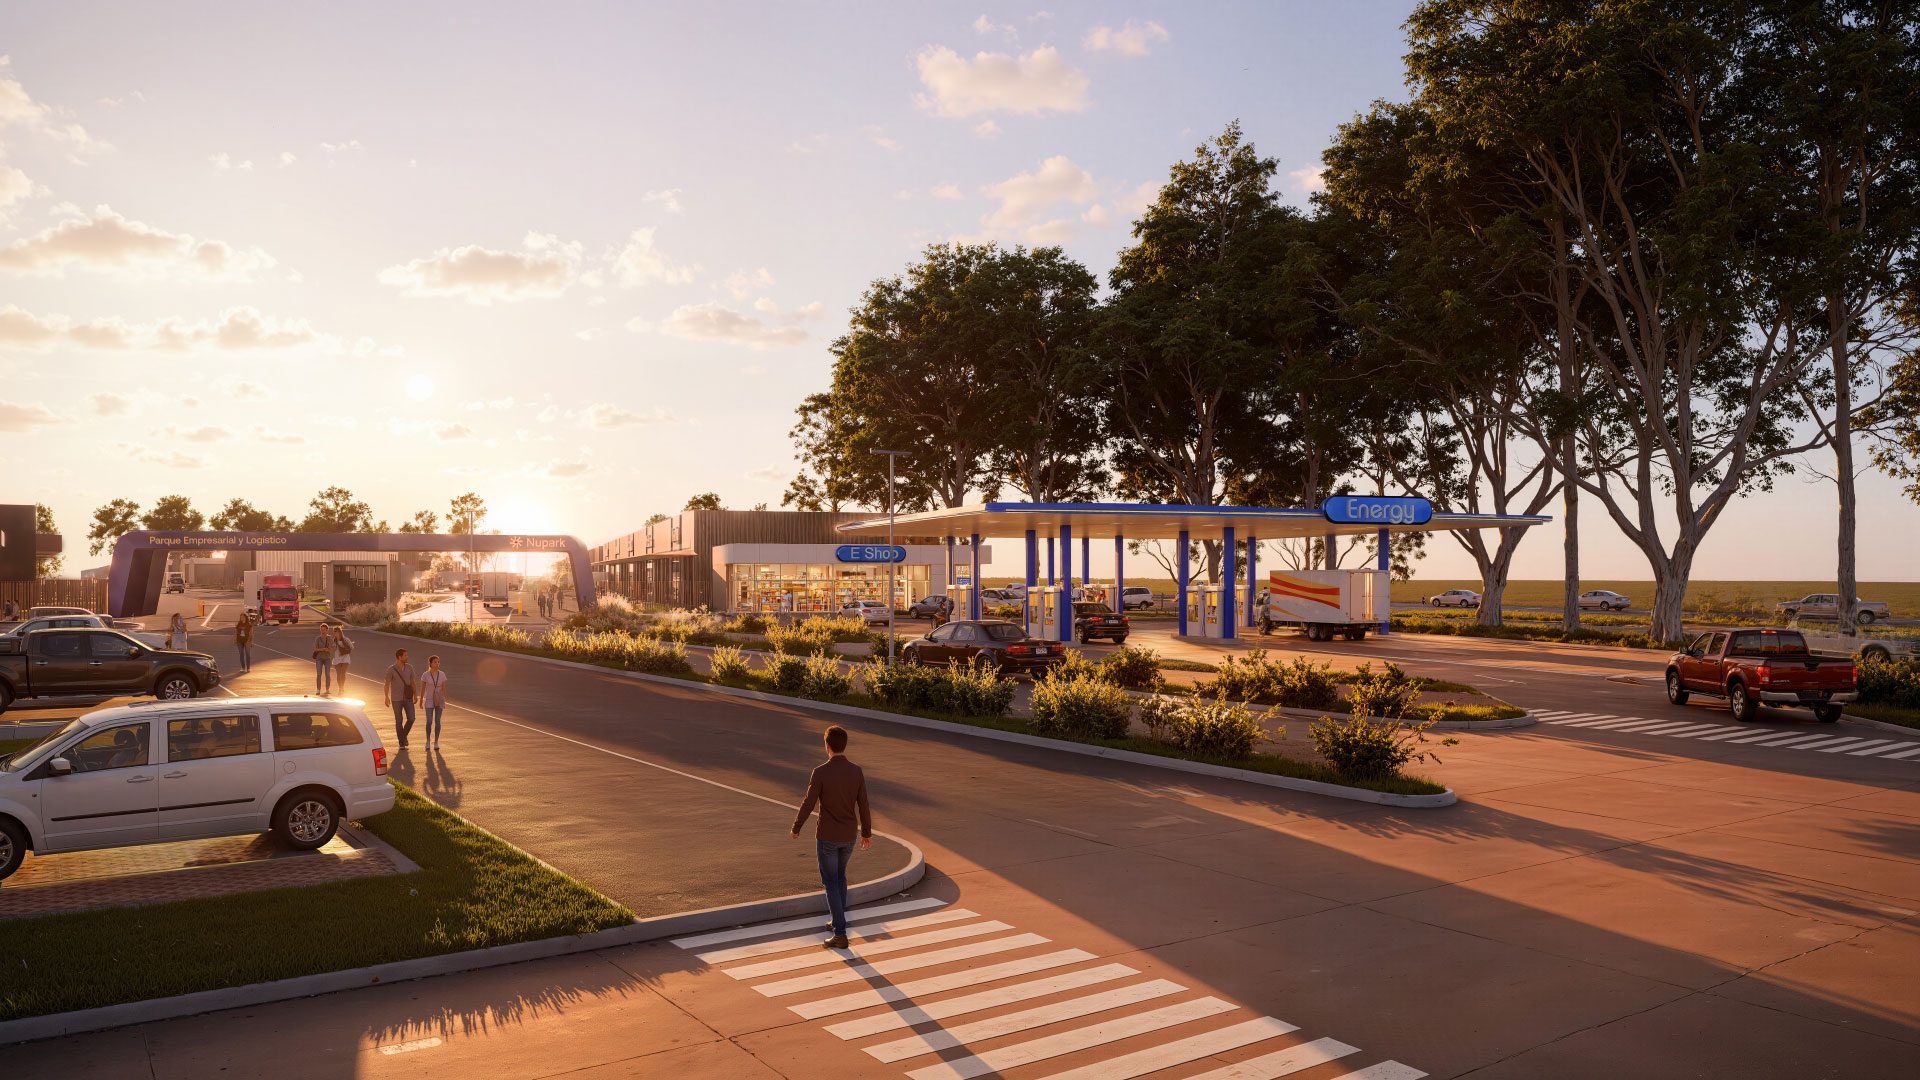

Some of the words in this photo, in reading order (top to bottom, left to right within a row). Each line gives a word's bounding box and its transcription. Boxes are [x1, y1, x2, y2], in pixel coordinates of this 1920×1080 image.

[1347, 498, 1415, 524] Energy
[149, 536, 181, 545] Parque
[183, 536, 236, 545] Empresarial
[238, 537, 243, 546] y
[246, 535, 287, 546] Logístico
[526, 537, 566, 549] Nupark
[850, 547, 860, 559] E
